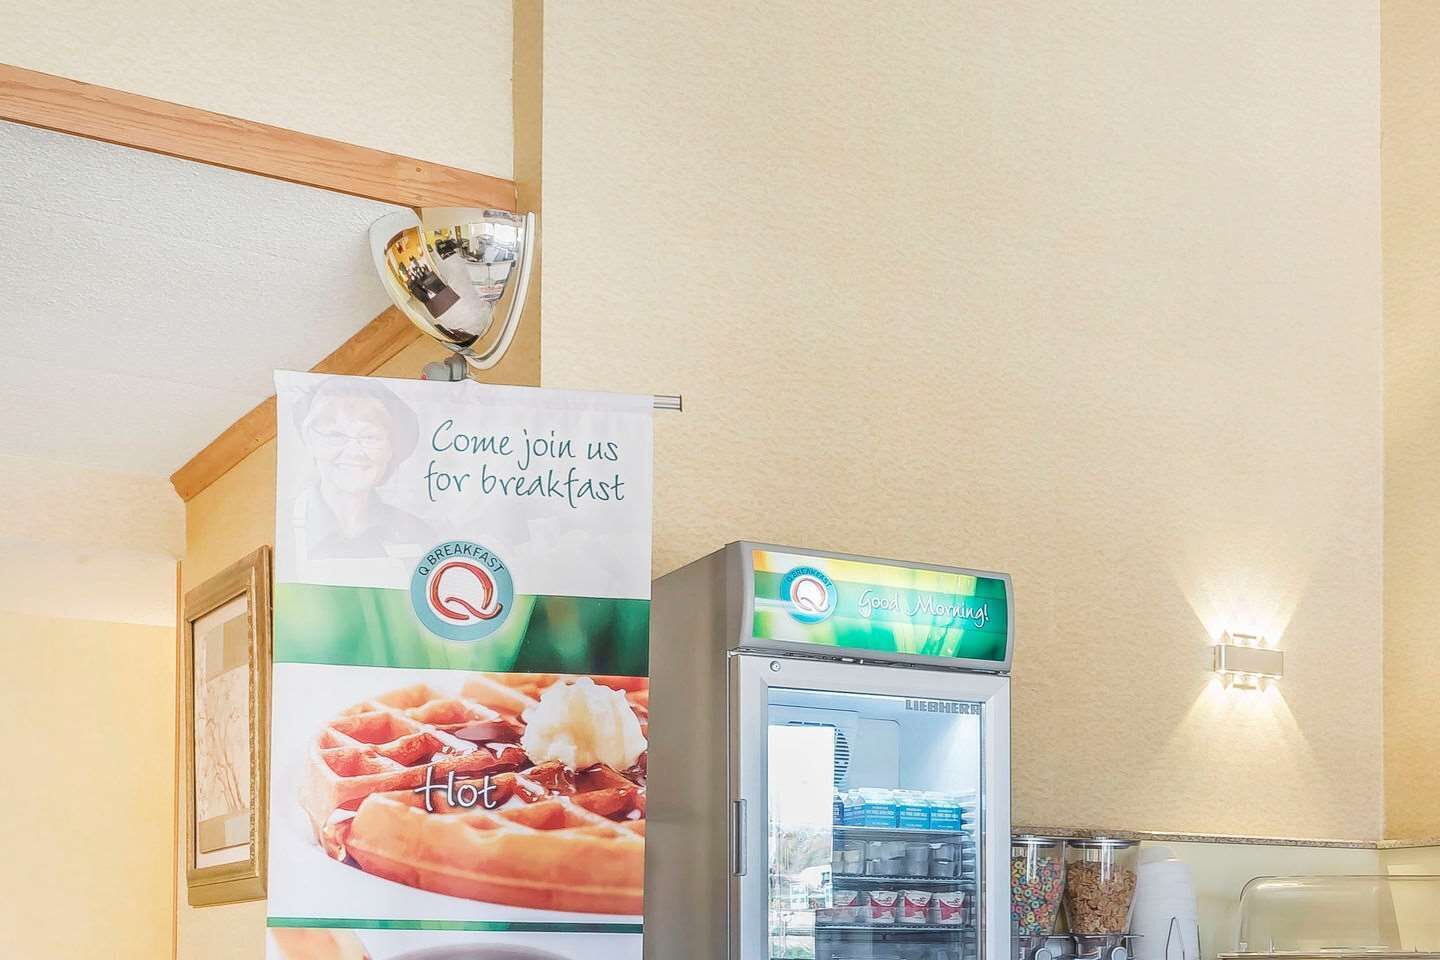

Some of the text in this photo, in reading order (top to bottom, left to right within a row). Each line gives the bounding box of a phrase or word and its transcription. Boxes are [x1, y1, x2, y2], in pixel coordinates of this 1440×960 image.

[431, 419, 618, 470] Come join us
[424, 460, 625, 508] for breakfast
[418, 543, 505, 576] Q BREAKFAST
[857, 588, 989, 628] Good Morning!
[905, 699, 981, 715] LIEBHERR
[415, 765, 498, 812] Hot
